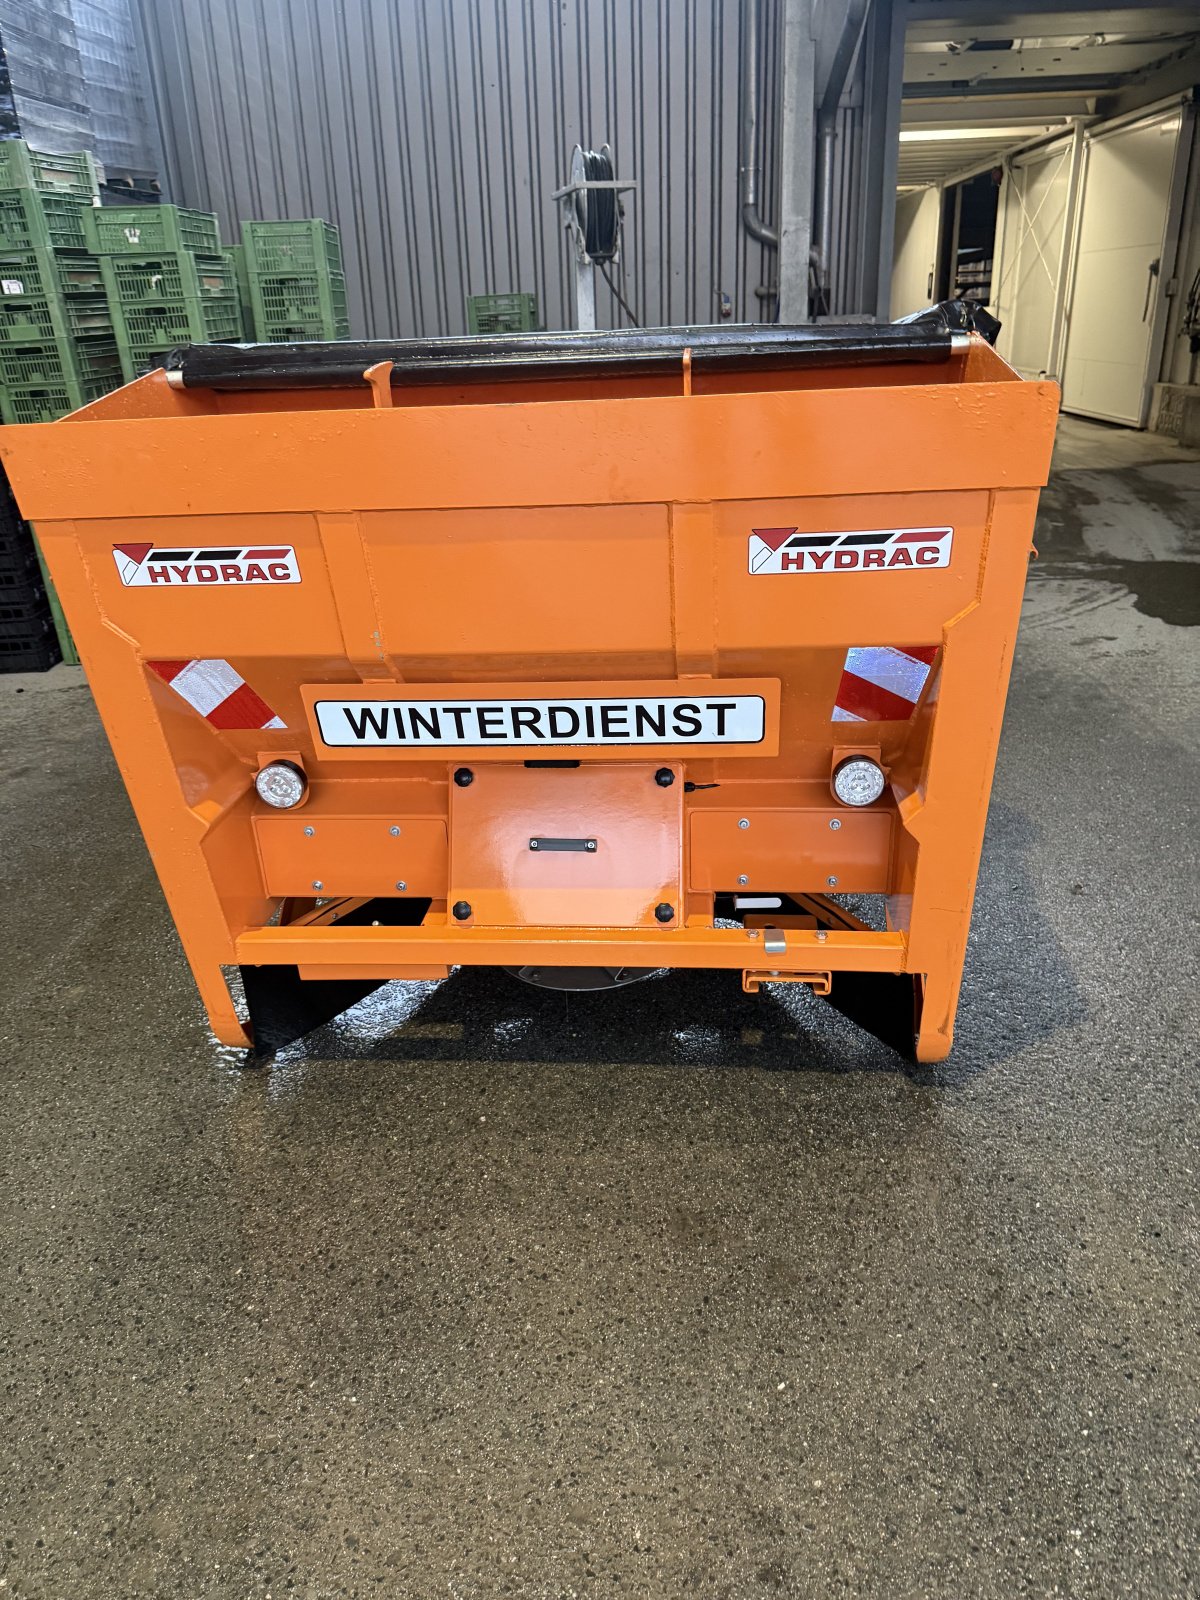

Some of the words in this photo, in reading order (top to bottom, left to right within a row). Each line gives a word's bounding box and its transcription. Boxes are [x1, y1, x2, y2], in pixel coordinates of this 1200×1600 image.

[781, 546, 940, 571] HYDRAC
[147, 562, 292, 584] HYDRAC
[342, 703, 737, 741] WINTERDIENST
